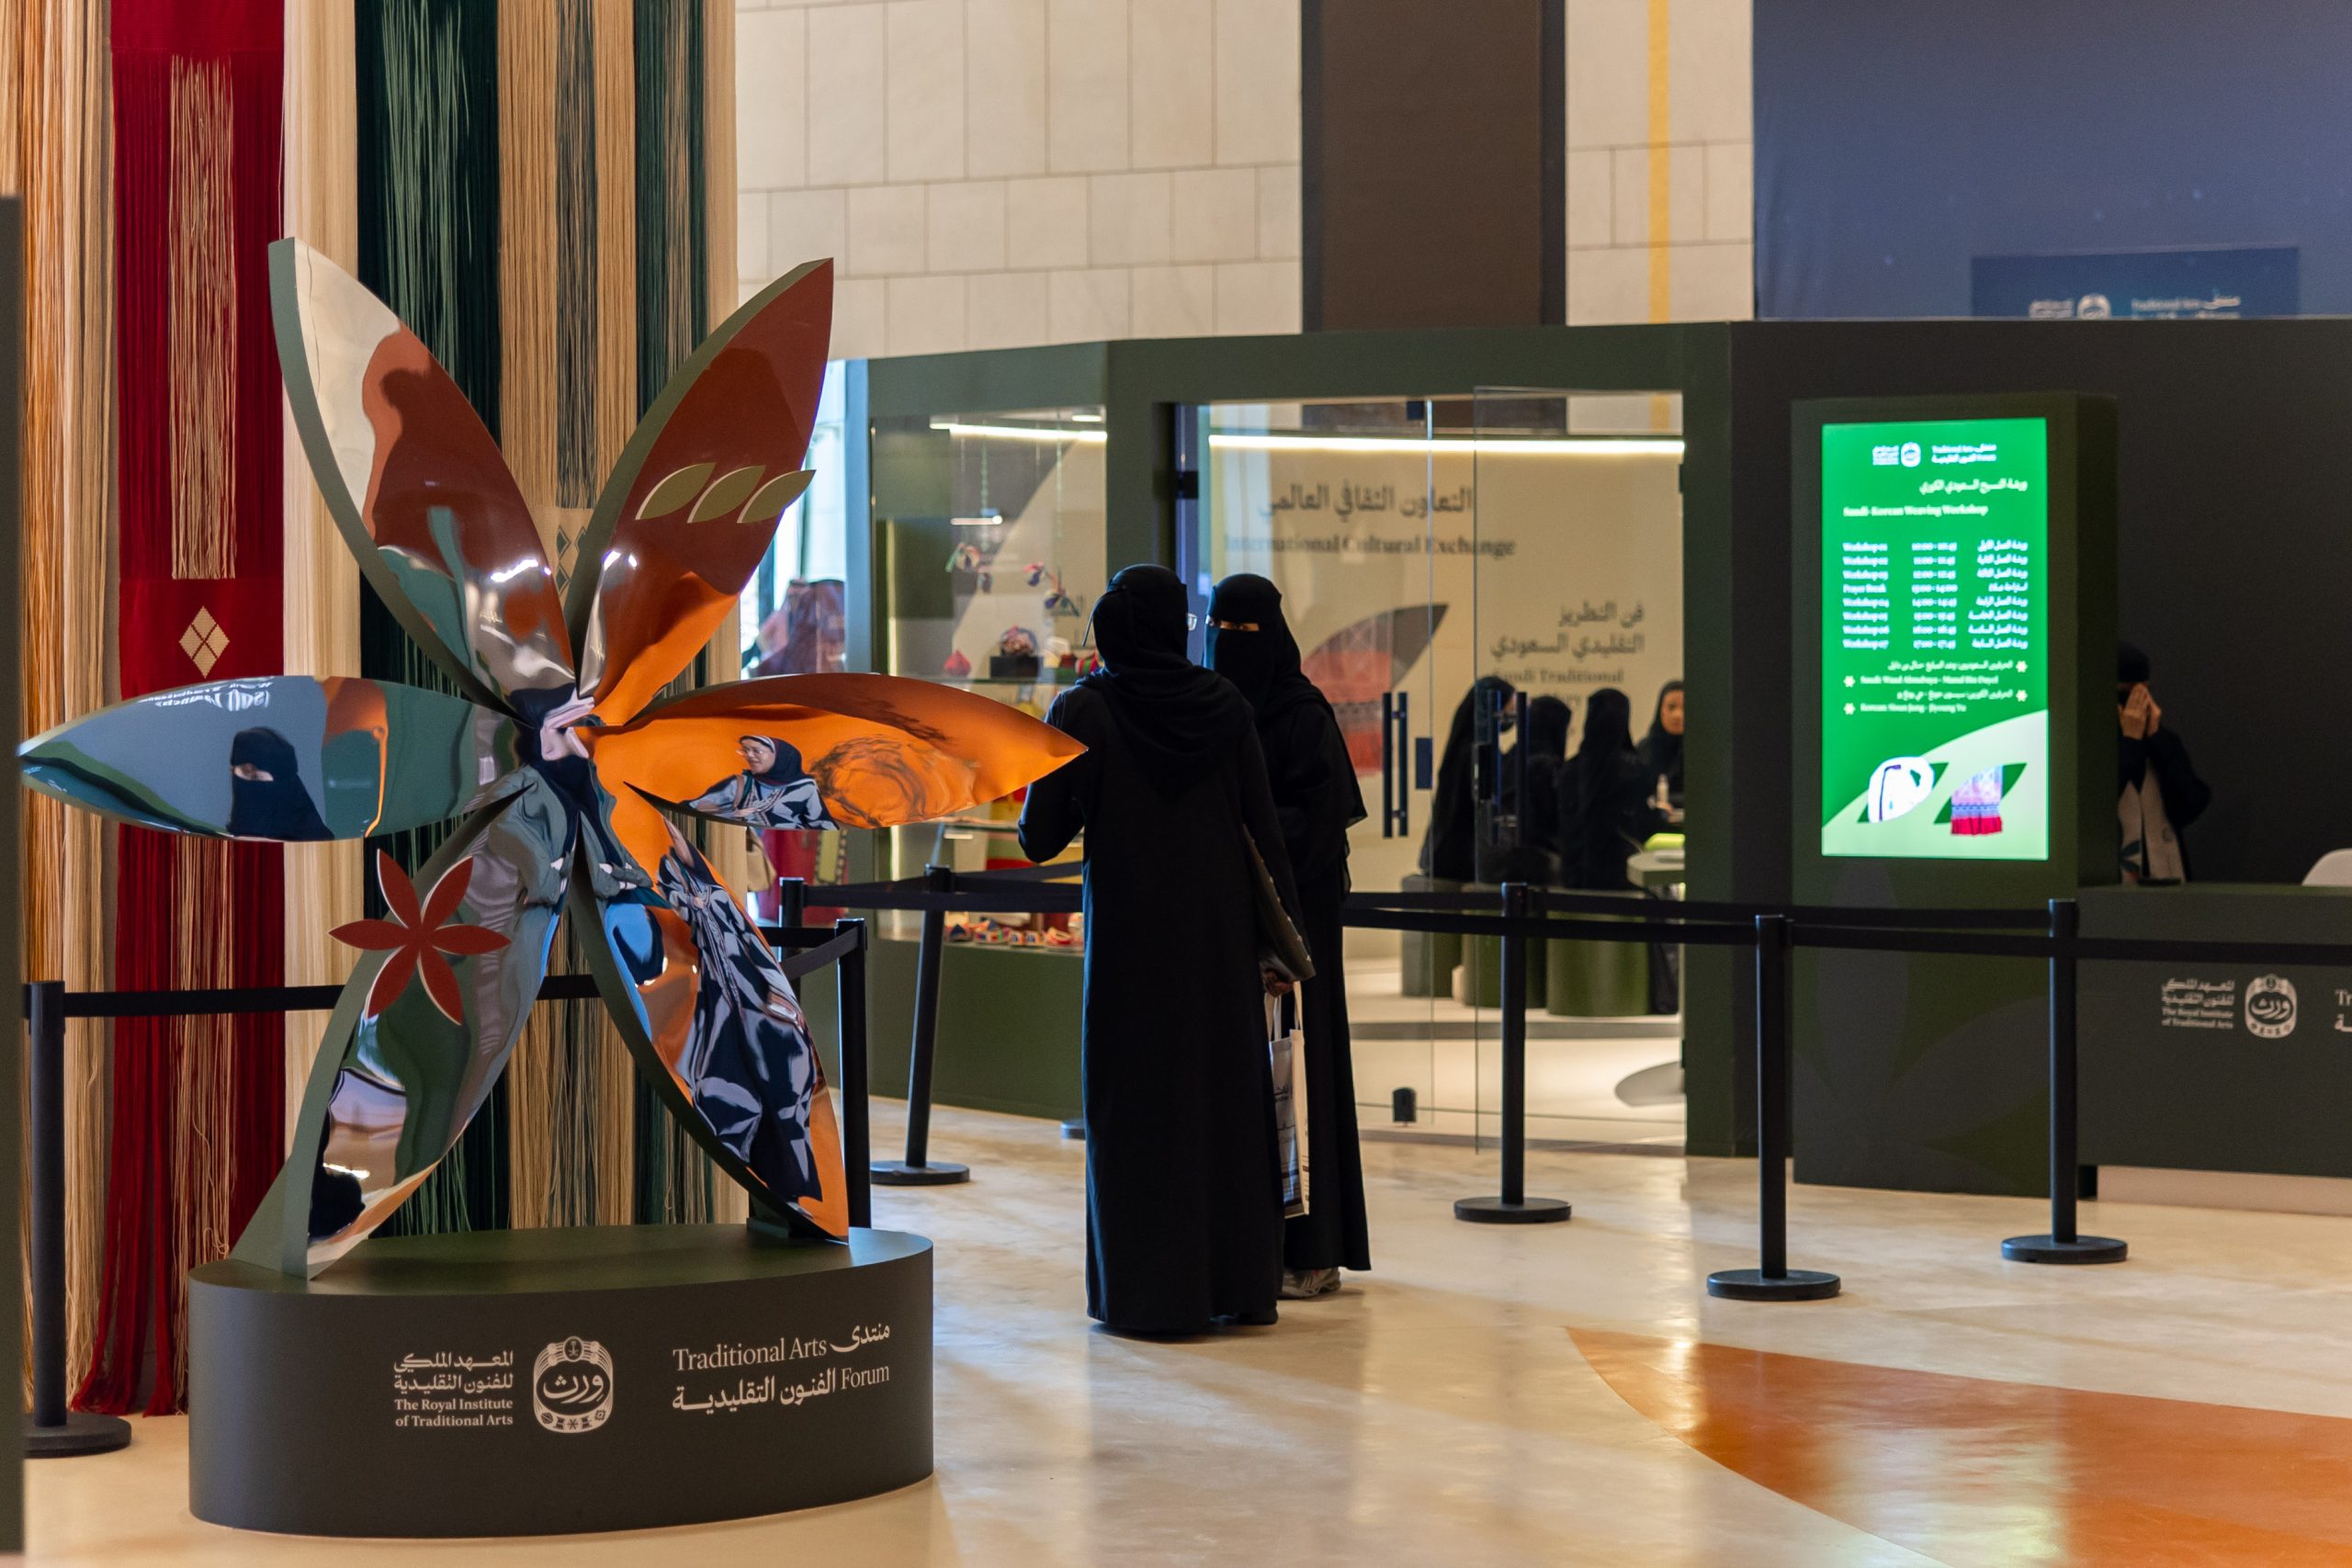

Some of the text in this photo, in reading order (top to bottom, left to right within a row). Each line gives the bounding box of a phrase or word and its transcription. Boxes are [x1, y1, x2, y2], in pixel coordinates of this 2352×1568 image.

[1335, 480, 1395, 524] الثقافي
[1399, 484, 1472, 519] التعاون
[830, 1323, 890, 1353] منتدى
[393, 1350, 514, 1372] المعهد الملكي
[673, 1337, 827, 1371] Traditional Arts
[394, 1372, 514, 1394] للفنون التقليدية
[672, 1367, 836, 1416] الفنون التقليدية
[840, 1365, 890, 1391] Forum
[394, 1398, 514, 1413] The Royal Institute
[395, 1415, 514, 1427] of Traditional Arts
